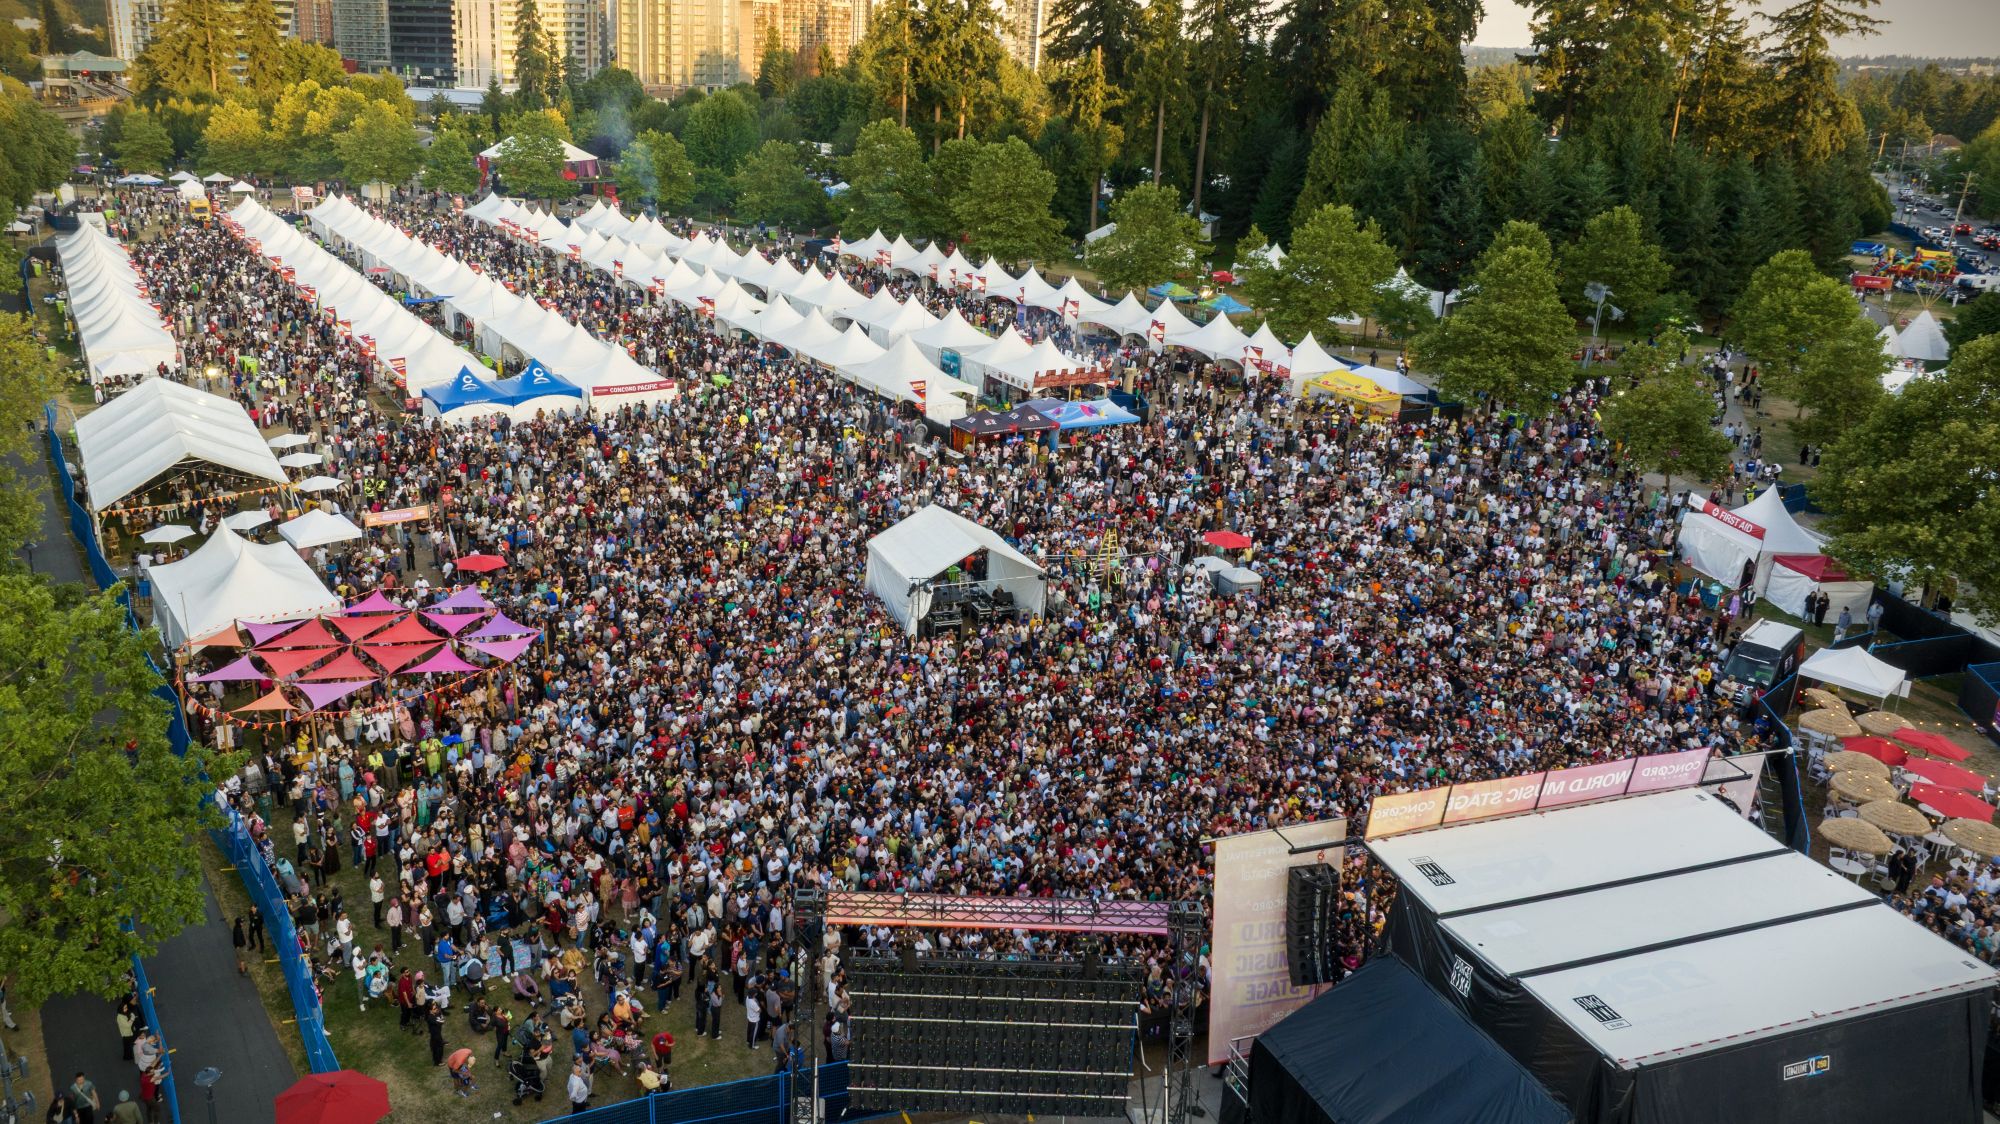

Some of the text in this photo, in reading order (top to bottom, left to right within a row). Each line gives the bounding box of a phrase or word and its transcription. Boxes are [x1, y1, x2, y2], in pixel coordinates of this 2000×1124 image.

[1719, 511, 1753, 533] FIRST AID
[1573, 995, 1608, 1011] STAGE
